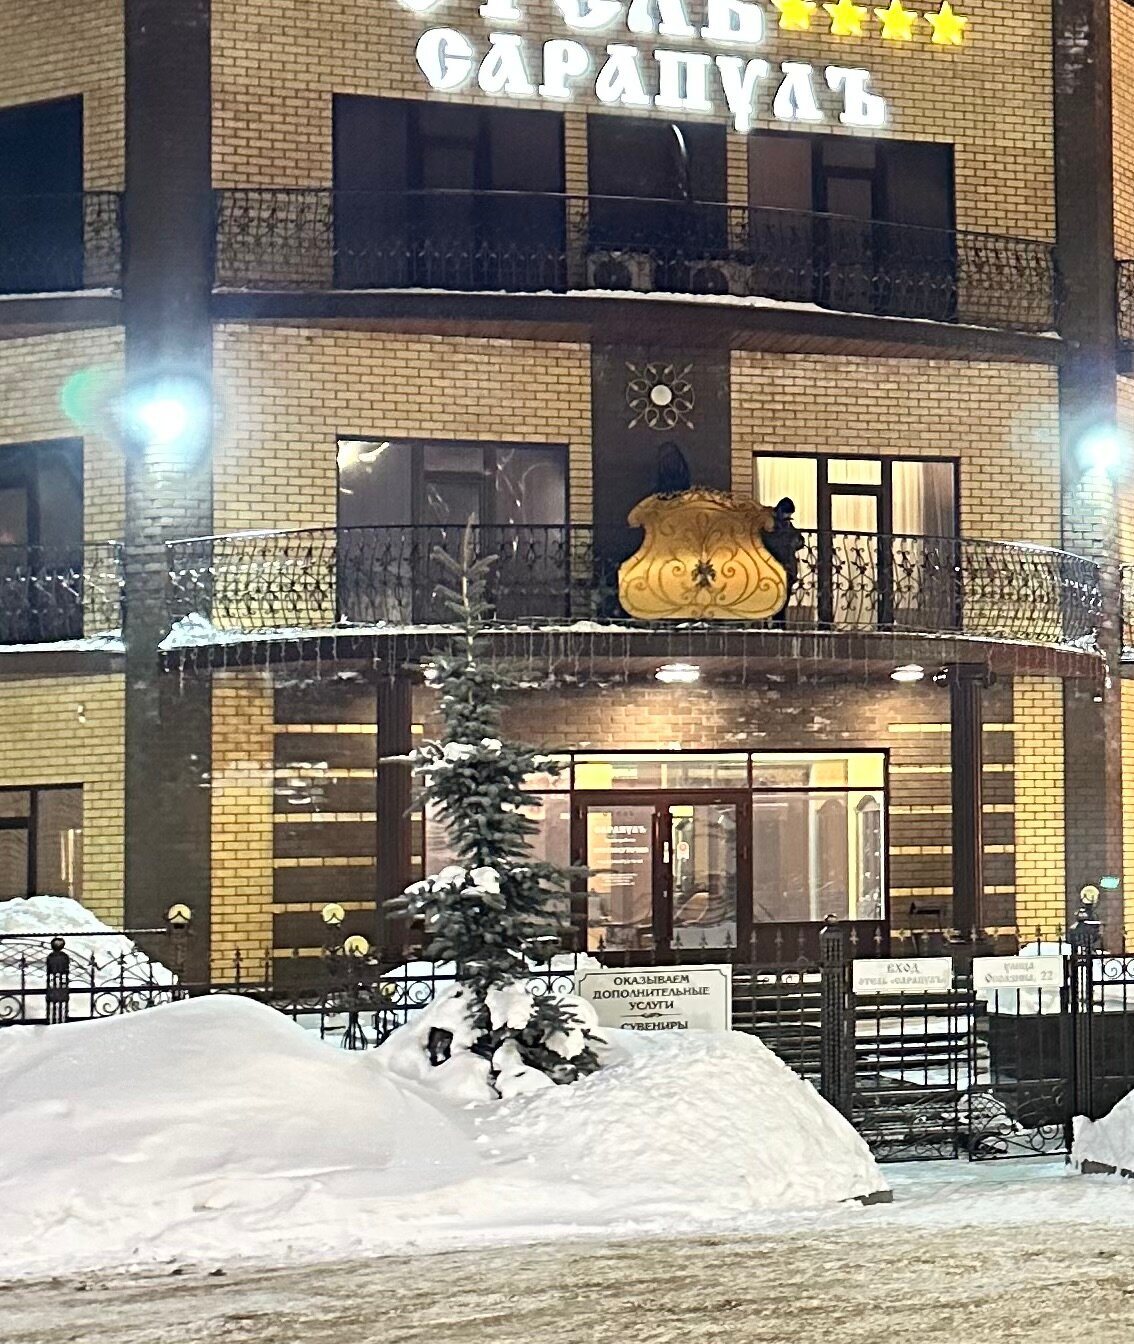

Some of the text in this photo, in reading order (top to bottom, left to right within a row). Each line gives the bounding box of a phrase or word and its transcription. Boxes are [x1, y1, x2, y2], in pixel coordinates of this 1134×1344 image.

[415, 27, 888, 133] САРАПУЛЪ
[613, 975, 690, 985] ОКАЗЫВАЕМ
[1041, 970, 1053, 980] 22
[592, 987, 711, 999] ДОПОЛНИТЕЛЬНЫЕ
[628, 1000, 674, 1010] УСЛУГИ
[619, 1021, 689, 1031] СУВЕНИРЫ
